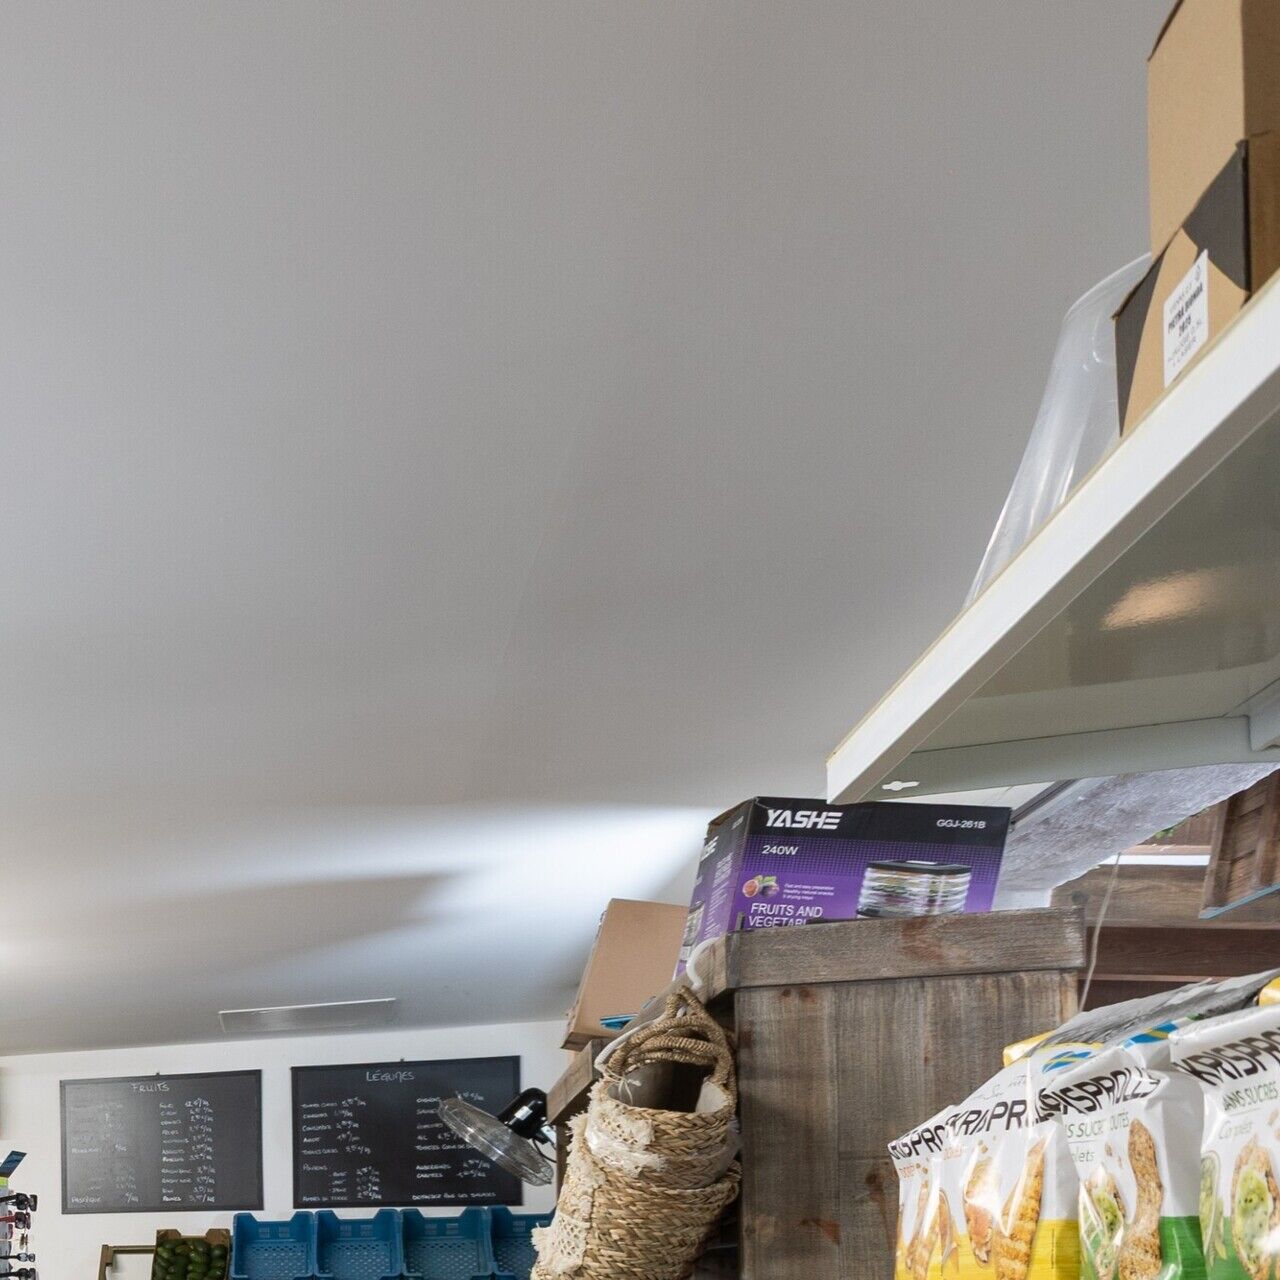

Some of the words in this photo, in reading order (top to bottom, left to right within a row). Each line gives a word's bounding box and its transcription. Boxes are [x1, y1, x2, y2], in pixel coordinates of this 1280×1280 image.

[764, 808, 843, 830] YASHE
[761, 843, 799, 856] 240W
[750, 902, 795, 916] FRUITS
[795, 905, 824, 918] AND
[130, 1082, 170, 1092] FRUITS
